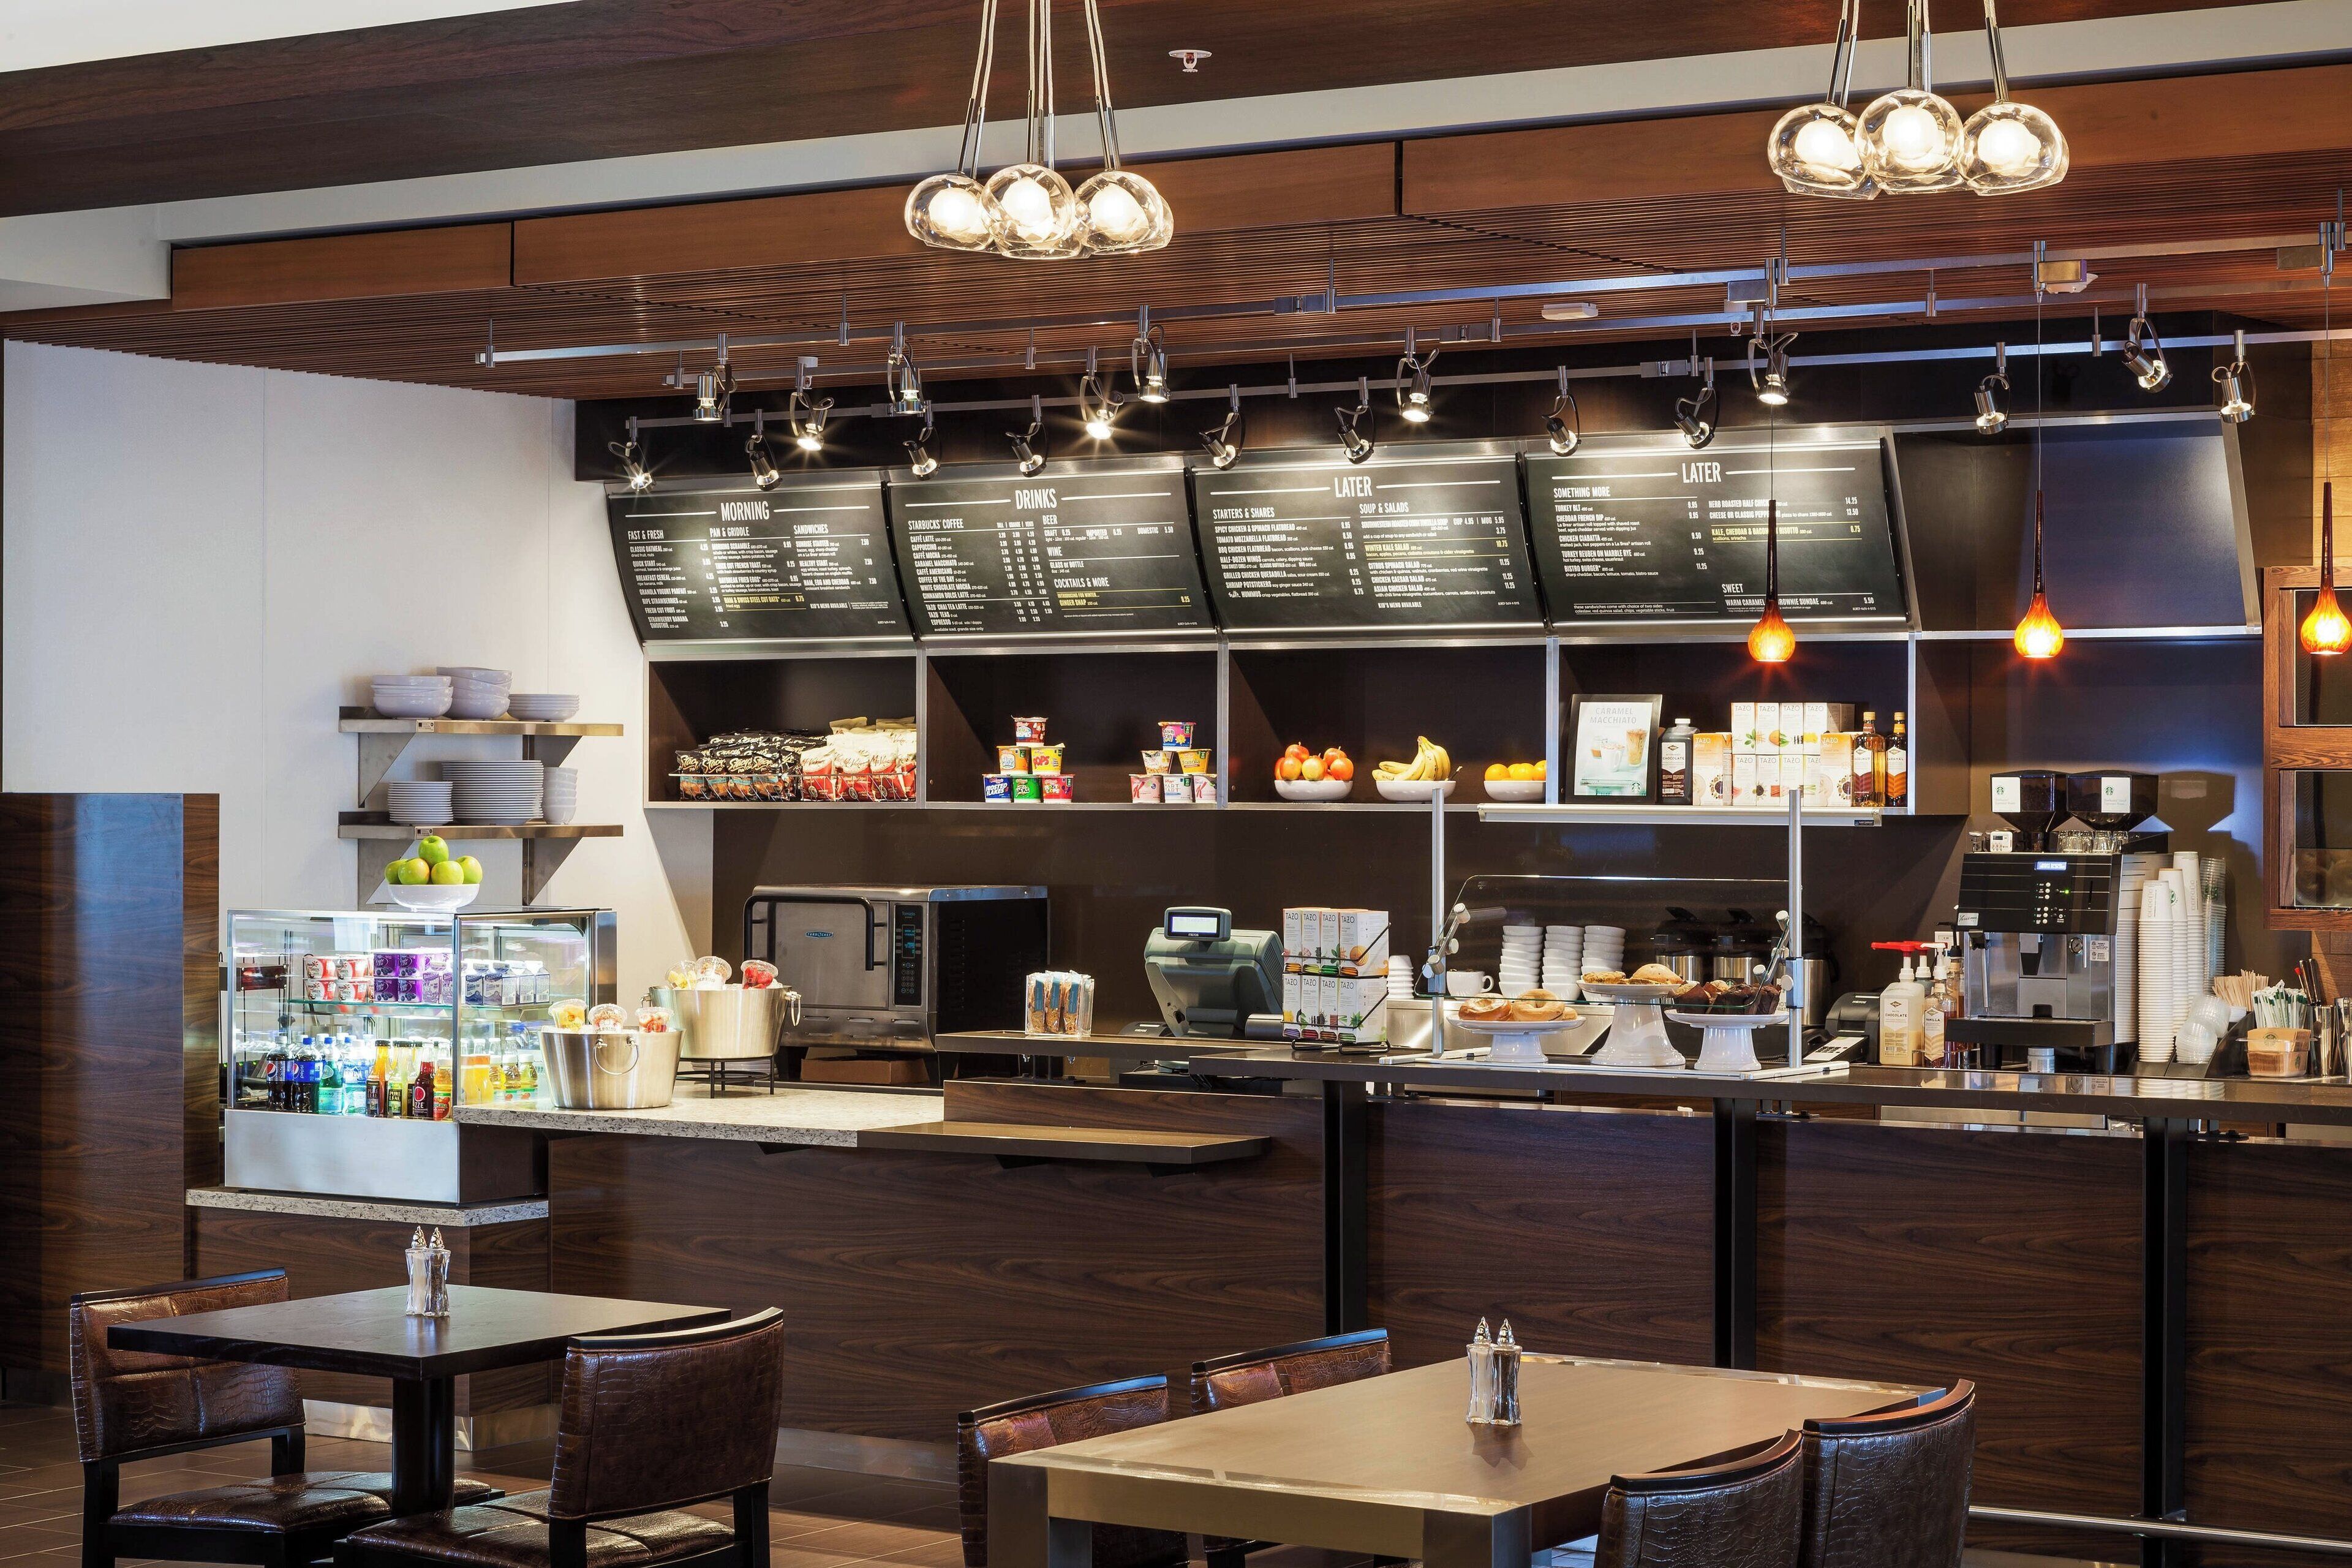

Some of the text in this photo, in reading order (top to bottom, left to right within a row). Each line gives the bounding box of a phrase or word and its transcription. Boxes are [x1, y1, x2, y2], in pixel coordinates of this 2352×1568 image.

[1682, 462, 1722, 483] LATER
[1334, 476, 1372, 498] LATER
[1554, 486, 1610, 498] SOMETHING MORE
[1015, 488, 1057, 510] DRINKS
[721, 501, 769, 521] MORNING
[1213, 507, 1275, 519] STARTERS & SHARES
[1359, 502, 1409, 514] SOUP & SALADS
[943, 519, 963, 529] COFFEE
[1042, 515, 1058, 525] BEER
[628, 530, 664, 540] FAST & FRESH
[709, 527, 721, 537] PAN
[727, 527, 750, 537] GRIDDLE
[793, 524, 829, 535] SANDWICHES
[1047, 546, 1063, 557] WINE
[1054, 578, 1109, 589] COCKTAILS & MORE
[1722, 584, 1743, 593] SWEET
